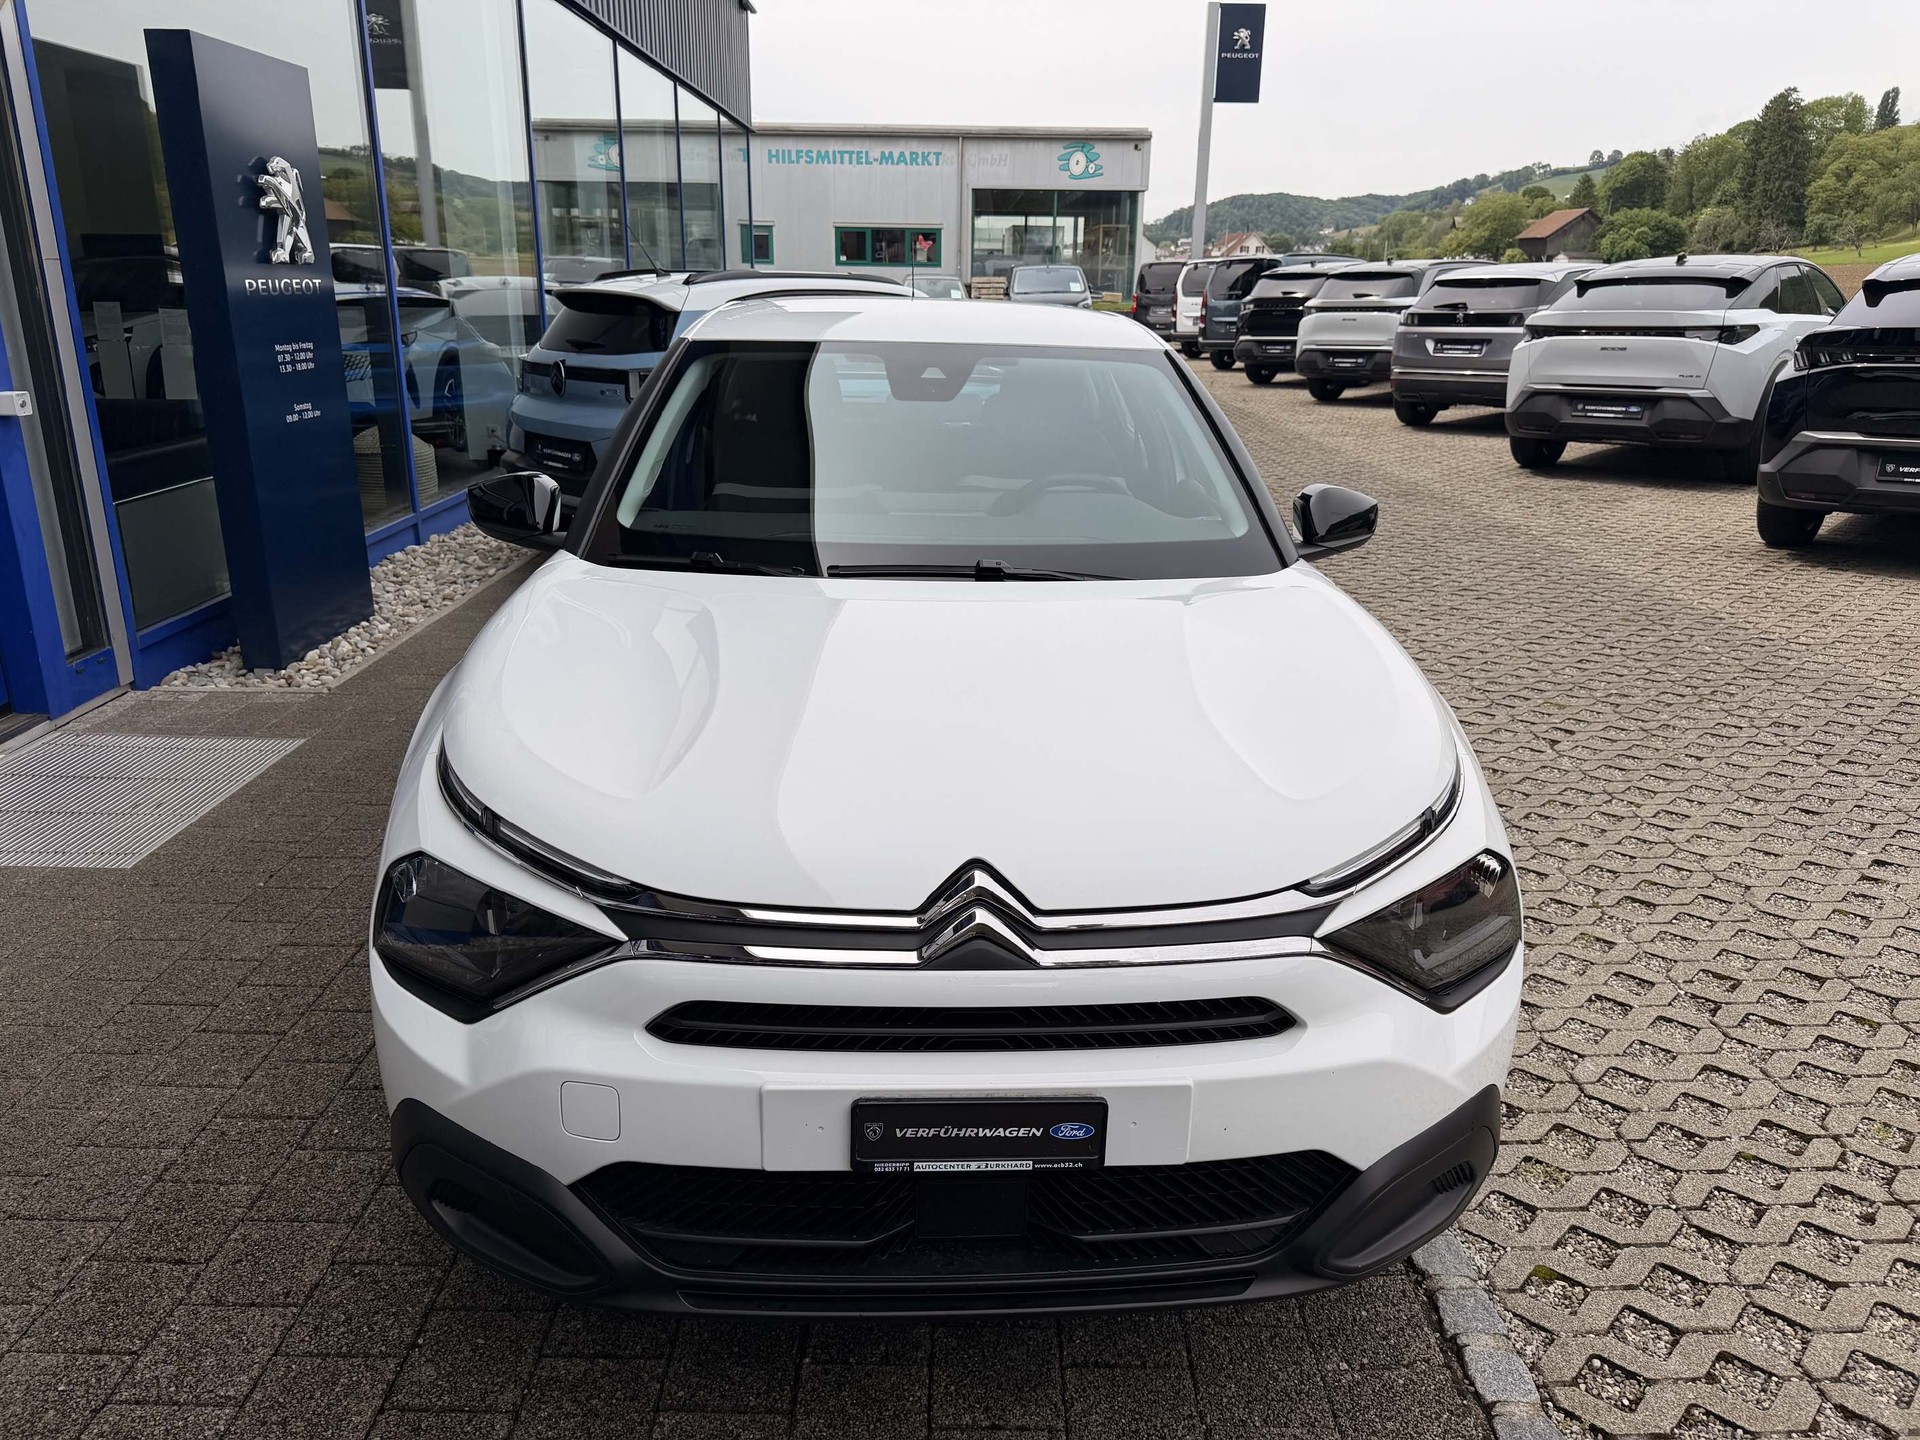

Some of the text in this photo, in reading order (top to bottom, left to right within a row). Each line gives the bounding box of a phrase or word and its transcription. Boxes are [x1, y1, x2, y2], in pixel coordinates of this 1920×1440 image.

[767, 149, 942, 167] HILFSMITTEL-MARKT
[245, 279, 322, 296] PEUGEOT
[275, 344, 292, 352] Montag
[299, 341, 314, 350] Freitag
[277, 354, 291, 362] 07.30
[294, 403, 312, 411] Samstag
[895, 1123, 1087, 1138] VERFÜHRWAGEN Ford
